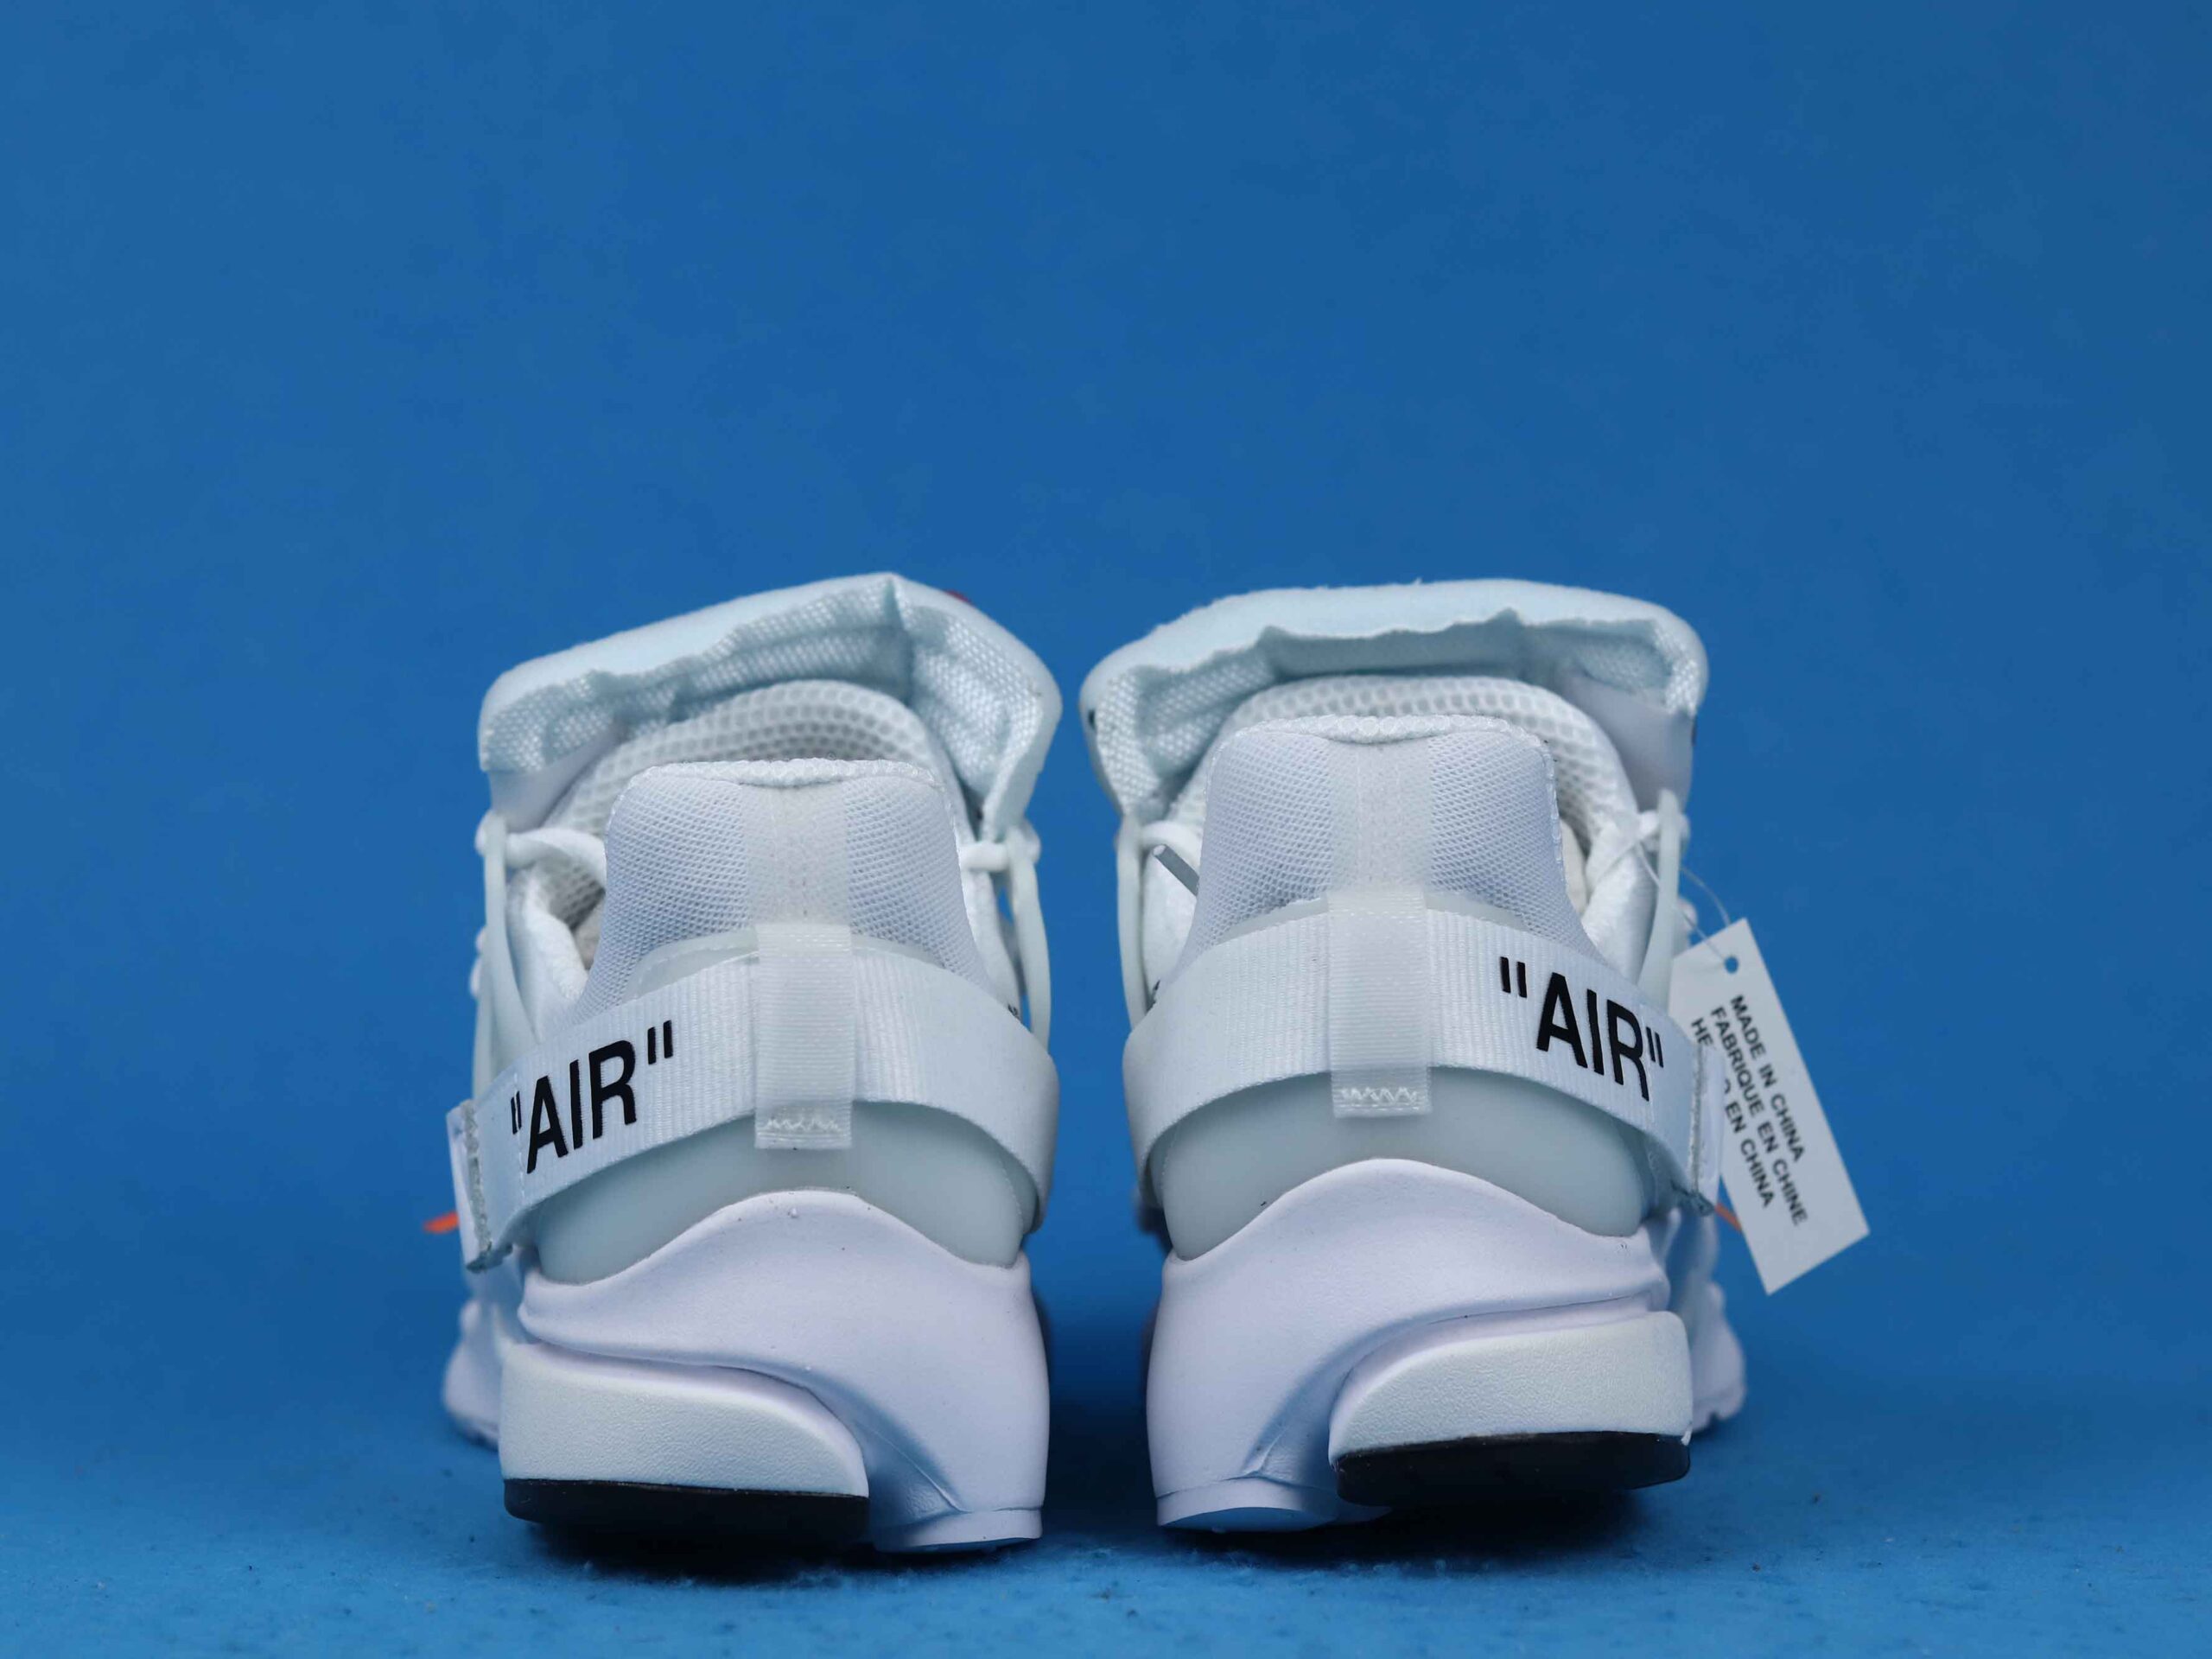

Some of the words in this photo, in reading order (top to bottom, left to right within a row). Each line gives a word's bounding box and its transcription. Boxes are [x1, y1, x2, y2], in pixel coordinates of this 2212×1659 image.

[510, 1020, 674, 1174] "AIR"
[1500, 956, 1664, 1102] "AIR"
[1731, 995, 1766, 1059] MADE
[1759, 1064, 1777, 1088] IN
[1771, 1093, 1805, 1162] CHINA
[1711, 1007, 1765, 1116] FABRIQUE
[1757, 1121, 1779, 1154] EN
[1773, 1159, 1808, 1226] CHINE
[1725, 1100, 1747, 1134] EN
[1740, 1139, 1775, 1208] CHINA
